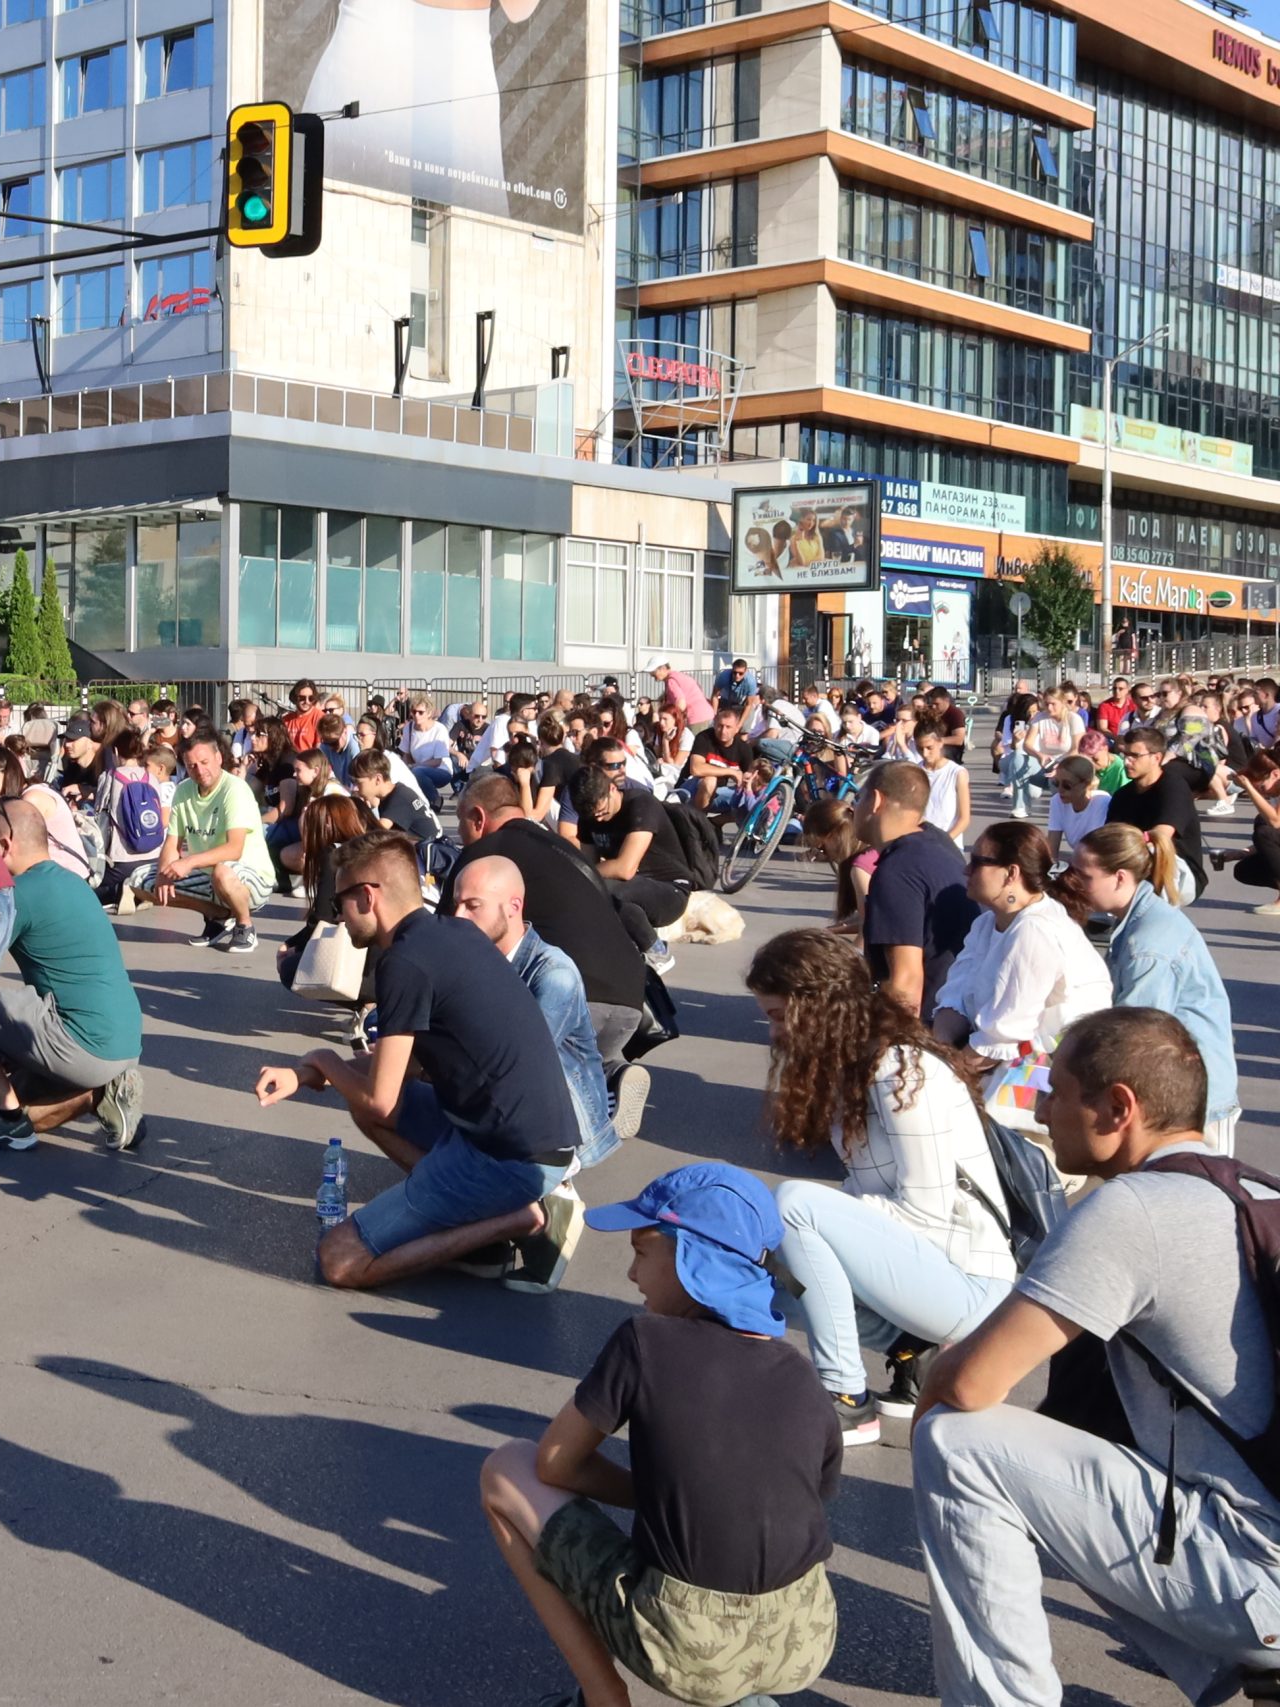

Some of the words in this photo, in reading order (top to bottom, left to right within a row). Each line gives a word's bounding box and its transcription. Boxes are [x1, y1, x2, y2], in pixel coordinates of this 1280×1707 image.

[1213, 28, 1261, 78] HEMUS
[886, 482, 918, 500] НАЕМ
[932, 488, 978, 505] МАГАЗИН
[897, 501, 918, 516] 868
[925, 501, 986, 520] ПАНОРАМА
[1128, 515, 1160, 539] ПОД
[1235, 531, 1265, 554] 630
[932, 547, 983, 568] МАГАЗИН
[1119, 570, 1152, 605] Kafe
[1155, 577, 1203, 613] Mania
